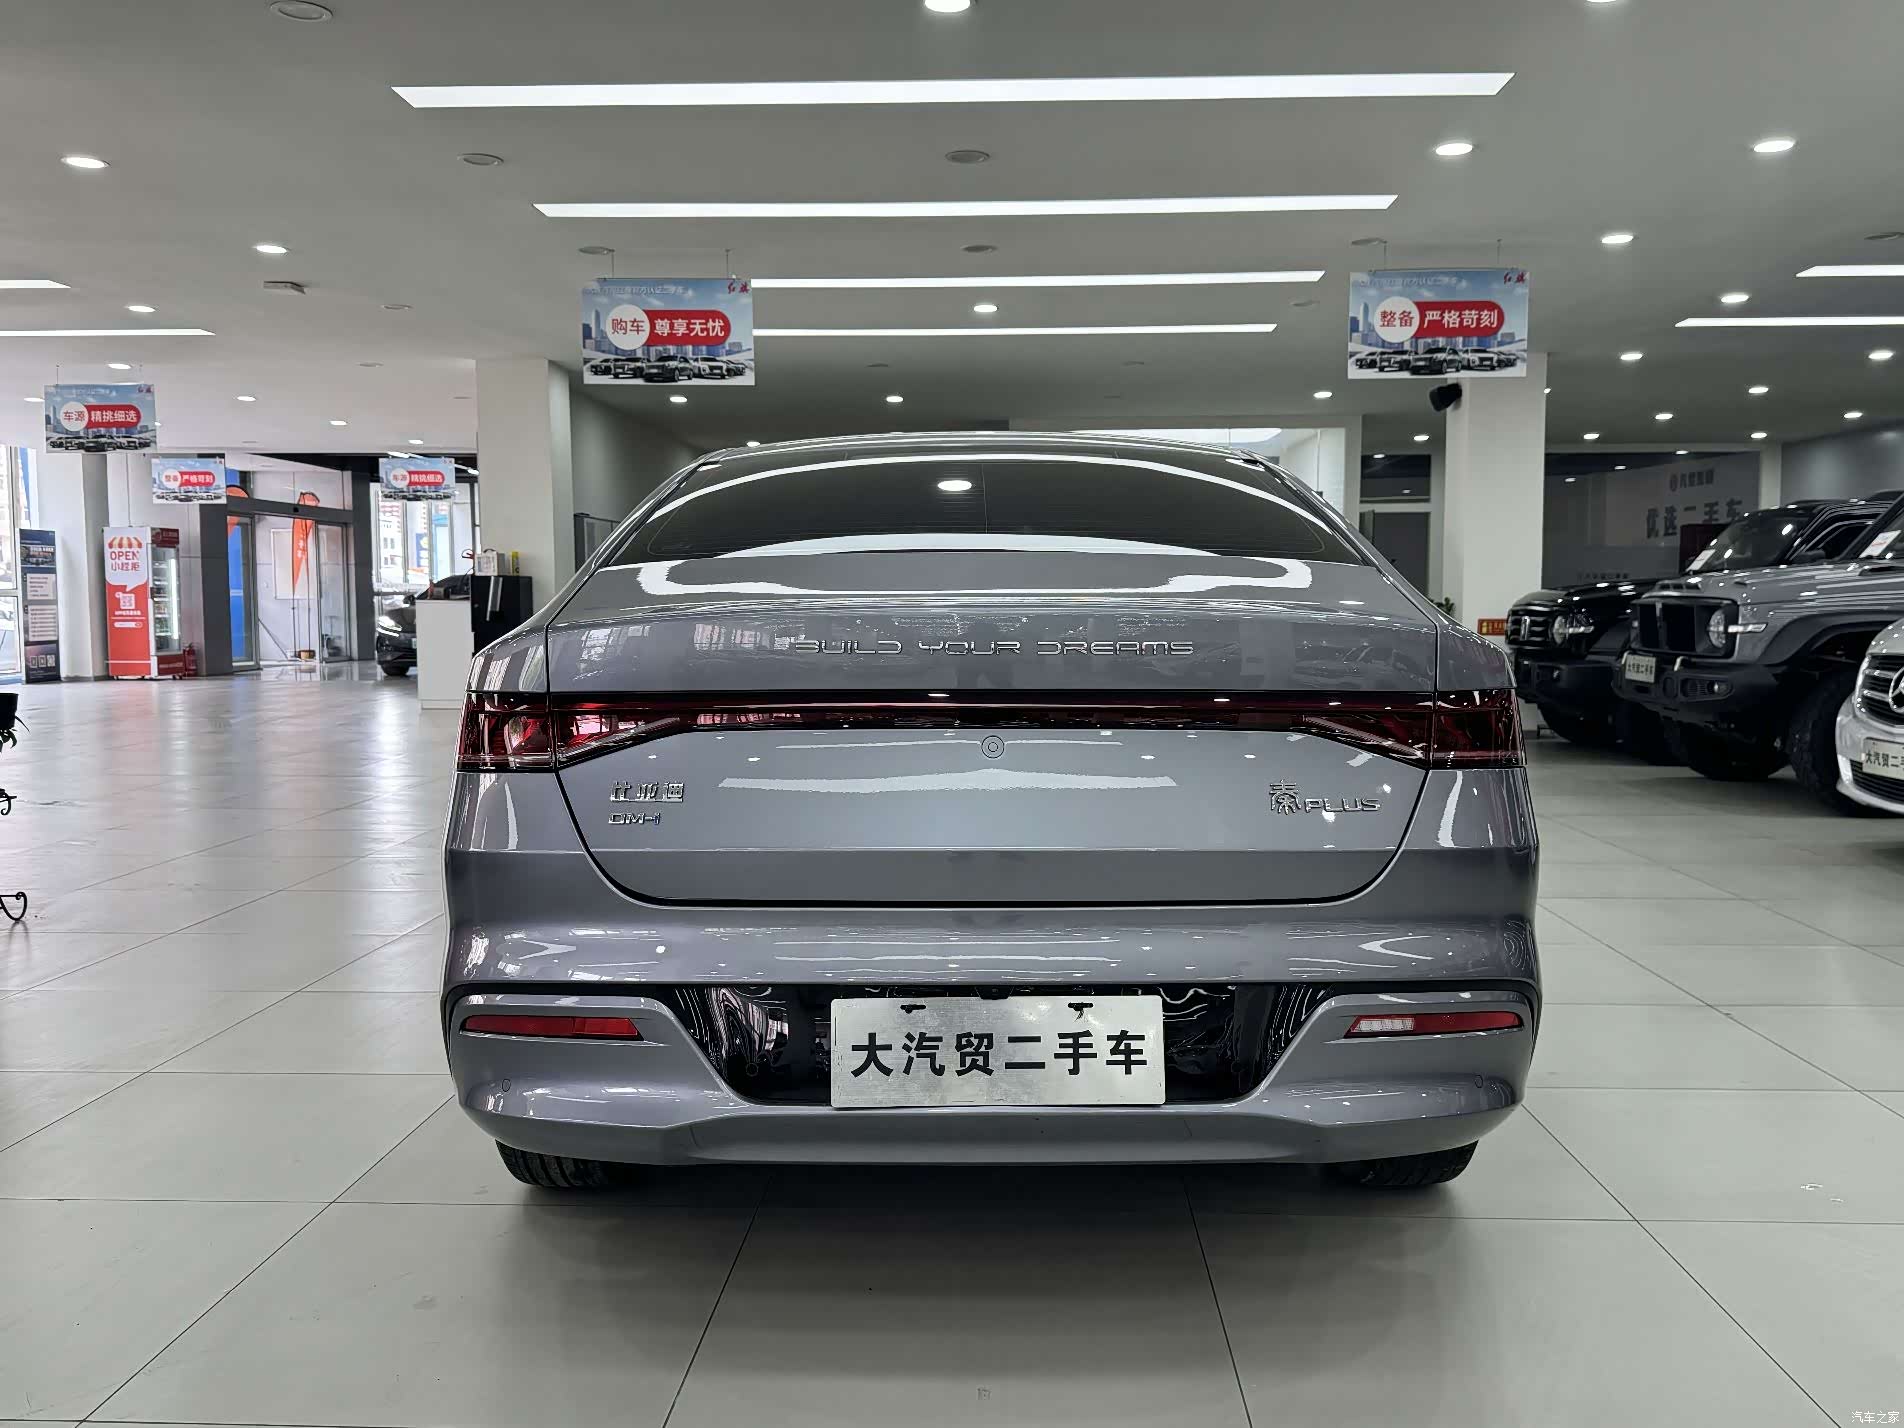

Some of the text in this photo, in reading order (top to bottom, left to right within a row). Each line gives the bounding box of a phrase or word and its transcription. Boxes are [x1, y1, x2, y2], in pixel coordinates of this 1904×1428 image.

[611, 318, 725, 337] 购车 尊享无忧
[1380, 309, 1498, 328] 整备 严格苛刻
[110, 551, 139, 561] OPEN
[794, 639, 1195, 654] BUILD YOUR DREAMS
[609, 781, 684, 802] 比亚迪
[850, 1030, 1149, 1077] 大汽贸二手车
